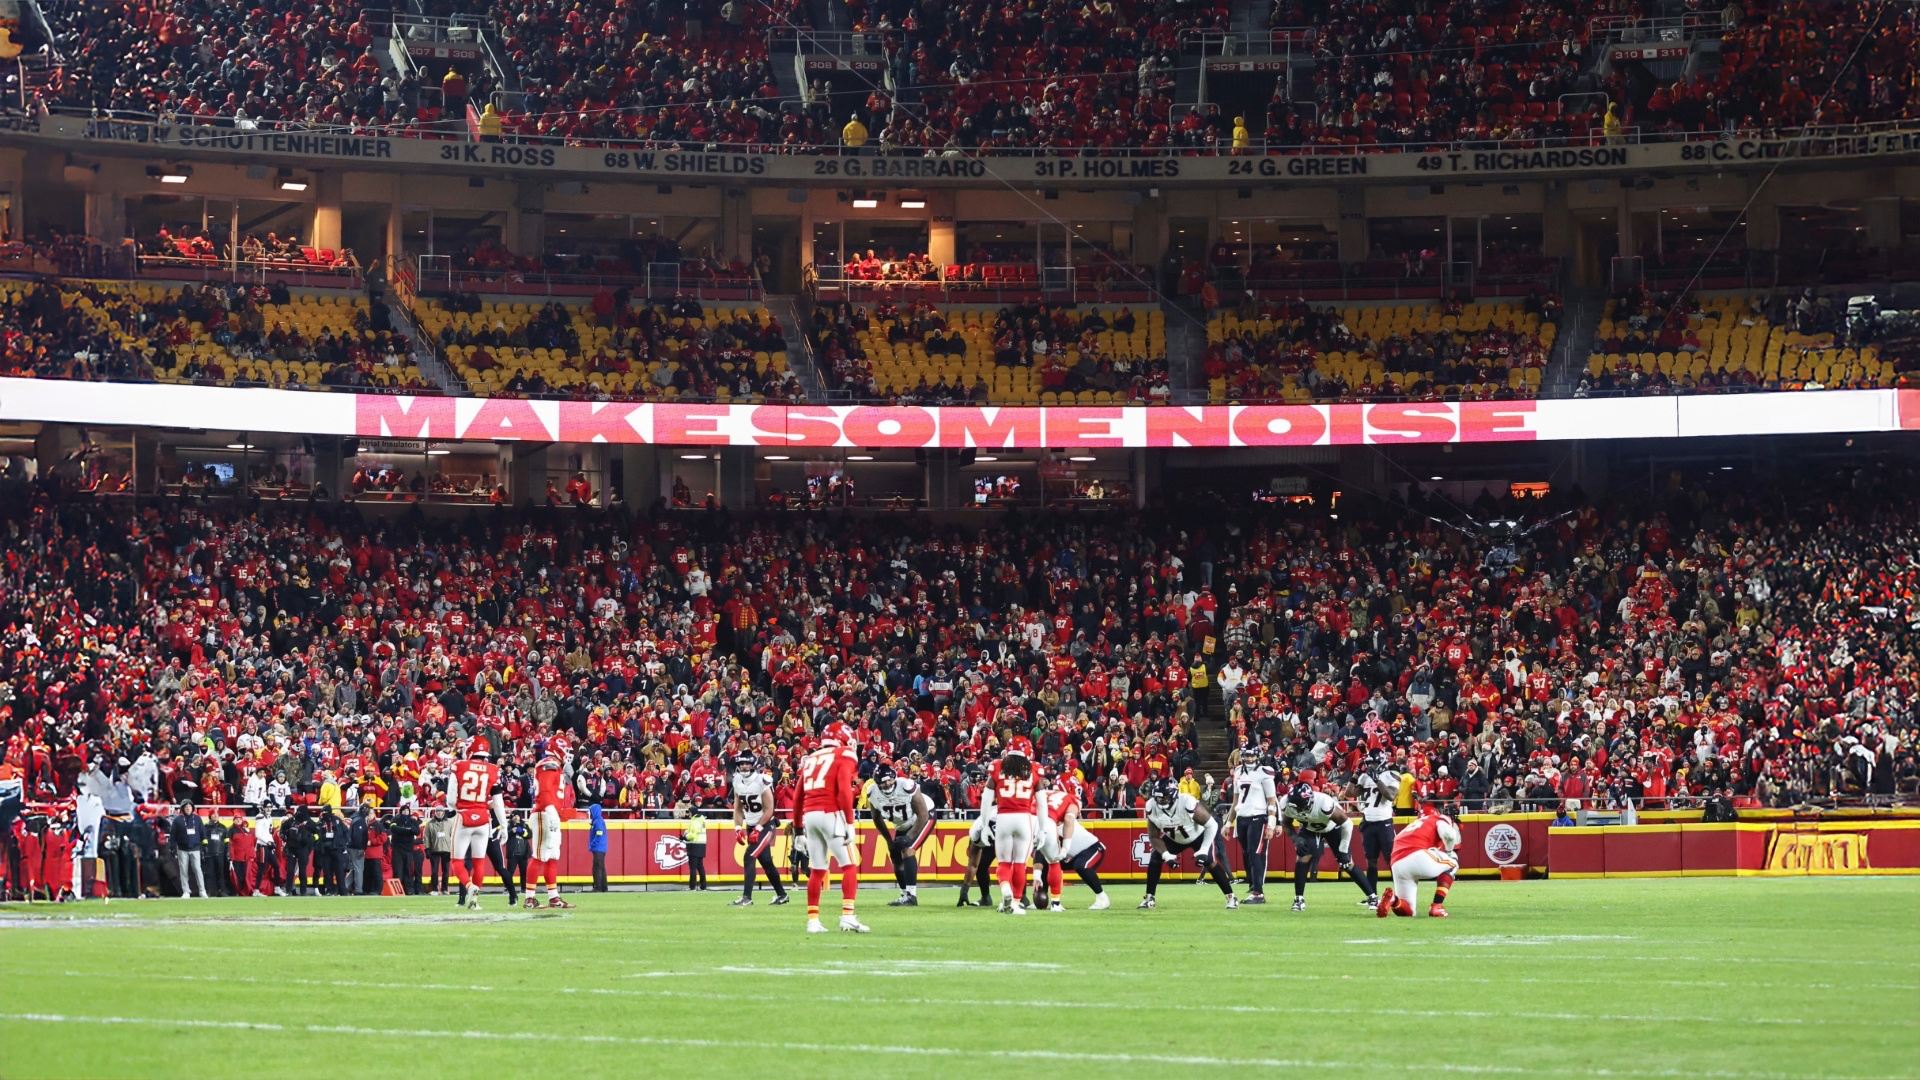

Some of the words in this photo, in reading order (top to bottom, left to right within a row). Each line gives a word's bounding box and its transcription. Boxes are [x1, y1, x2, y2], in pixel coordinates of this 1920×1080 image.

[357, 26, 368, 34] 53
[452, 51, 476, 59] 308
[1615, 51, 1638, 59] 310
[1661, 49, 1683, 57] 311
[809, 61, 832, 69] 308
[855, 62, 878, 70] 309
[1257, 62, 1280, 70] 310
[179, 127, 390, 158] SCHOTTENHEIMER
[441, 145, 459, 160] 31
[464, 145, 486, 163] K.
[491, 147, 555, 167] ROSS
[1681, 145, 1706, 160] 88
[1712, 142, 1733, 160] C.
[604, 153, 629, 168] 68
[634, 153, 658, 171] W.
[664, 155, 764, 174] SHIELDS
[1417, 156, 1442, 170] 49
[1449, 153, 1467, 171] T.
[1474, 148, 1626, 170] RICHARDSON
[814, 160, 838, 174] 26
[843, 158, 867, 176] G.
[872, 158, 985, 178] BARBARO
[1036, 161, 1053, 175] 31
[1059, 160, 1077, 177] P.
[1084, 160, 1179, 177] HOLMES
[1228, 160, 1252, 175] 24
[1259, 158, 1281, 176] G.
[1288, 157, 1367, 176] GREEN
[355, 394, 730, 445] MAKE
[751, 404, 1123, 447] SOME
[1146, 400, 1537, 447] NOISE
[592, 555, 600, 564] 15
[678, 554, 688, 563] 58
[1339, 552, 1348, 561] 15
[238, 569, 247, 579] 15
[602, 603, 612, 612] 32
[344, 620, 354, 629] 15
[451, 616, 462, 624] 52
[1056, 620, 1066, 628] 87
[1033, 628, 1038, 638] 8
[1448, 649, 1460, 658] 58
[1645, 662, 1654, 670] 15
[544, 673, 553, 681] 15
[1169, 672, 1178, 681] 15
[641, 680, 646, 689] 7
[1534, 678, 1545, 689] 87
[1313, 689, 1323, 698] 15
[227, 726, 237, 738] 10
[250, 740, 259, 750] 15
[625, 748, 631, 757] 7
[1729, 751, 1739, 761] 15
[469, 763, 487, 772] HICKS
[804, 752, 835, 791] 27
[704, 774, 714, 783] 32
[277, 787, 286, 797] 51
[460, 772, 489, 803] 21
[999, 775, 1032, 799] 32
[1421, 785, 1427, 796] 4
[1440, 782, 1443, 792] 1
[1240, 784, 1252, 804] 7
[883, 804, 908, 821] 77
[1162, 825, 1190, 840] 71
[665, 843, 688, 861] KC
[389, 880, 403, 895] 10
